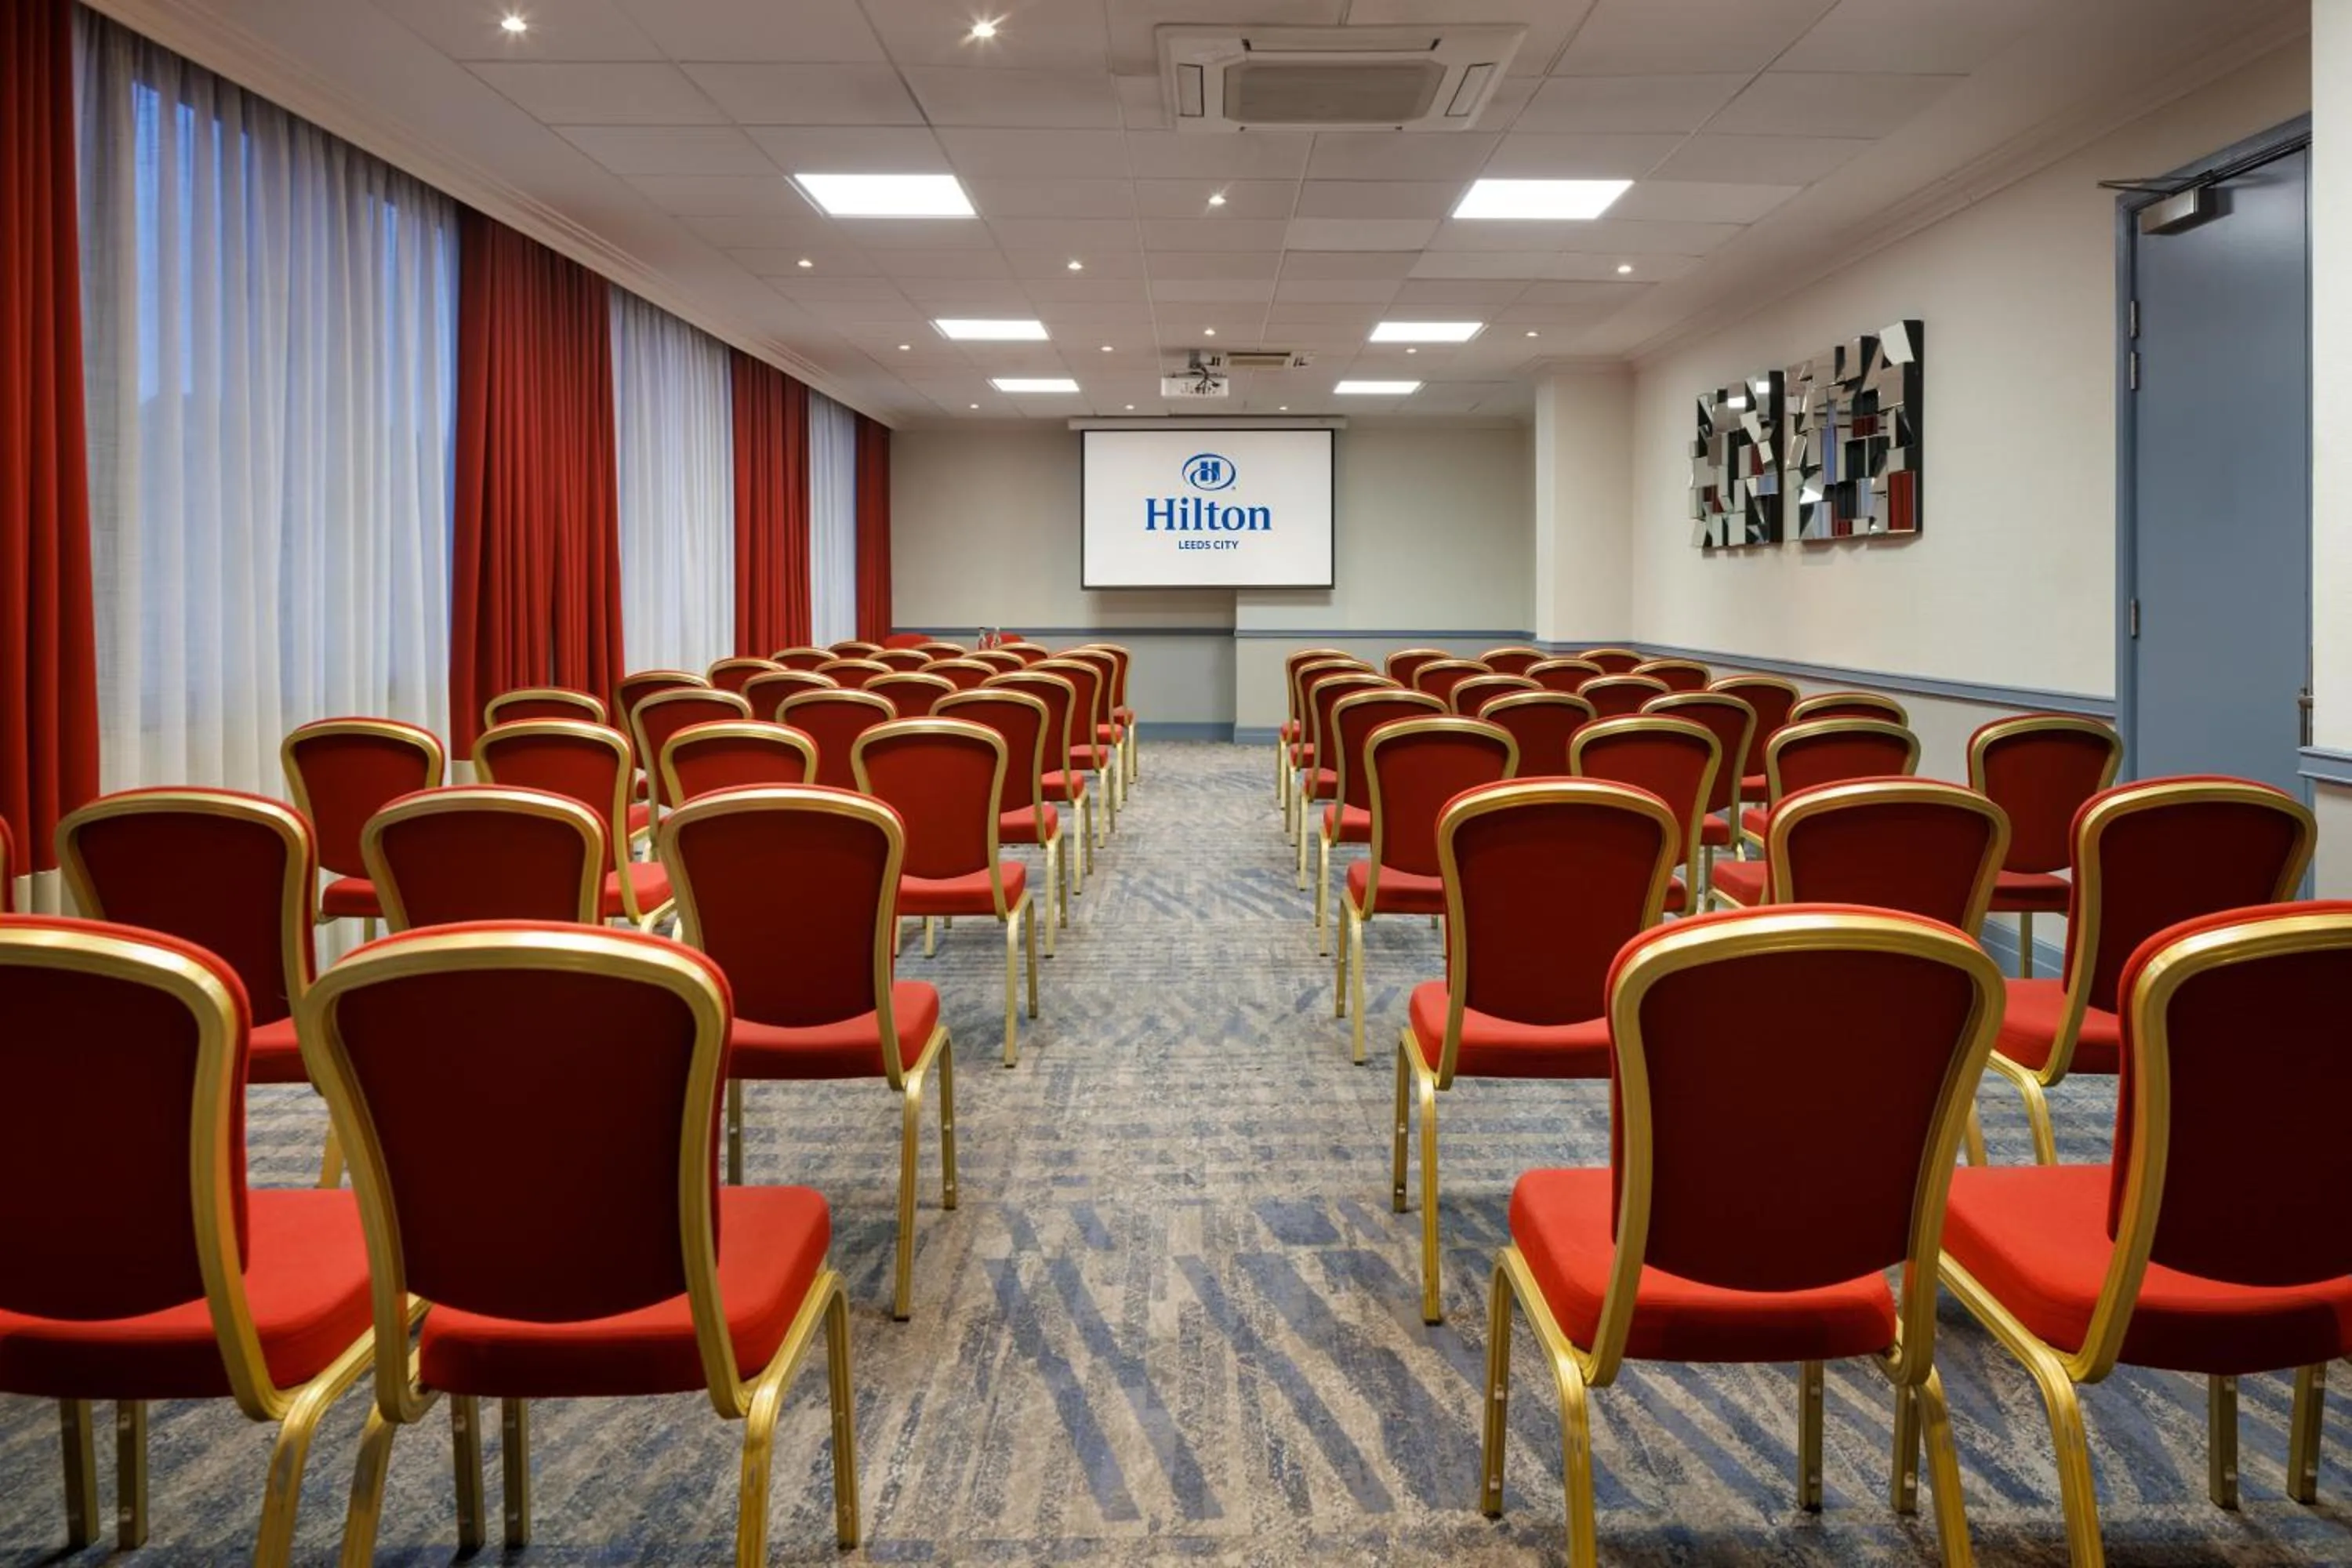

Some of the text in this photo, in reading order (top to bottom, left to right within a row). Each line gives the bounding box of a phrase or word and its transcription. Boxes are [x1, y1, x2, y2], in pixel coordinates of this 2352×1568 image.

[1200, 461, 1221, 481] H
[1145, 496, 1272, 531] Hilton
[1178, 539, 1240, 550] LEEDS CITY
